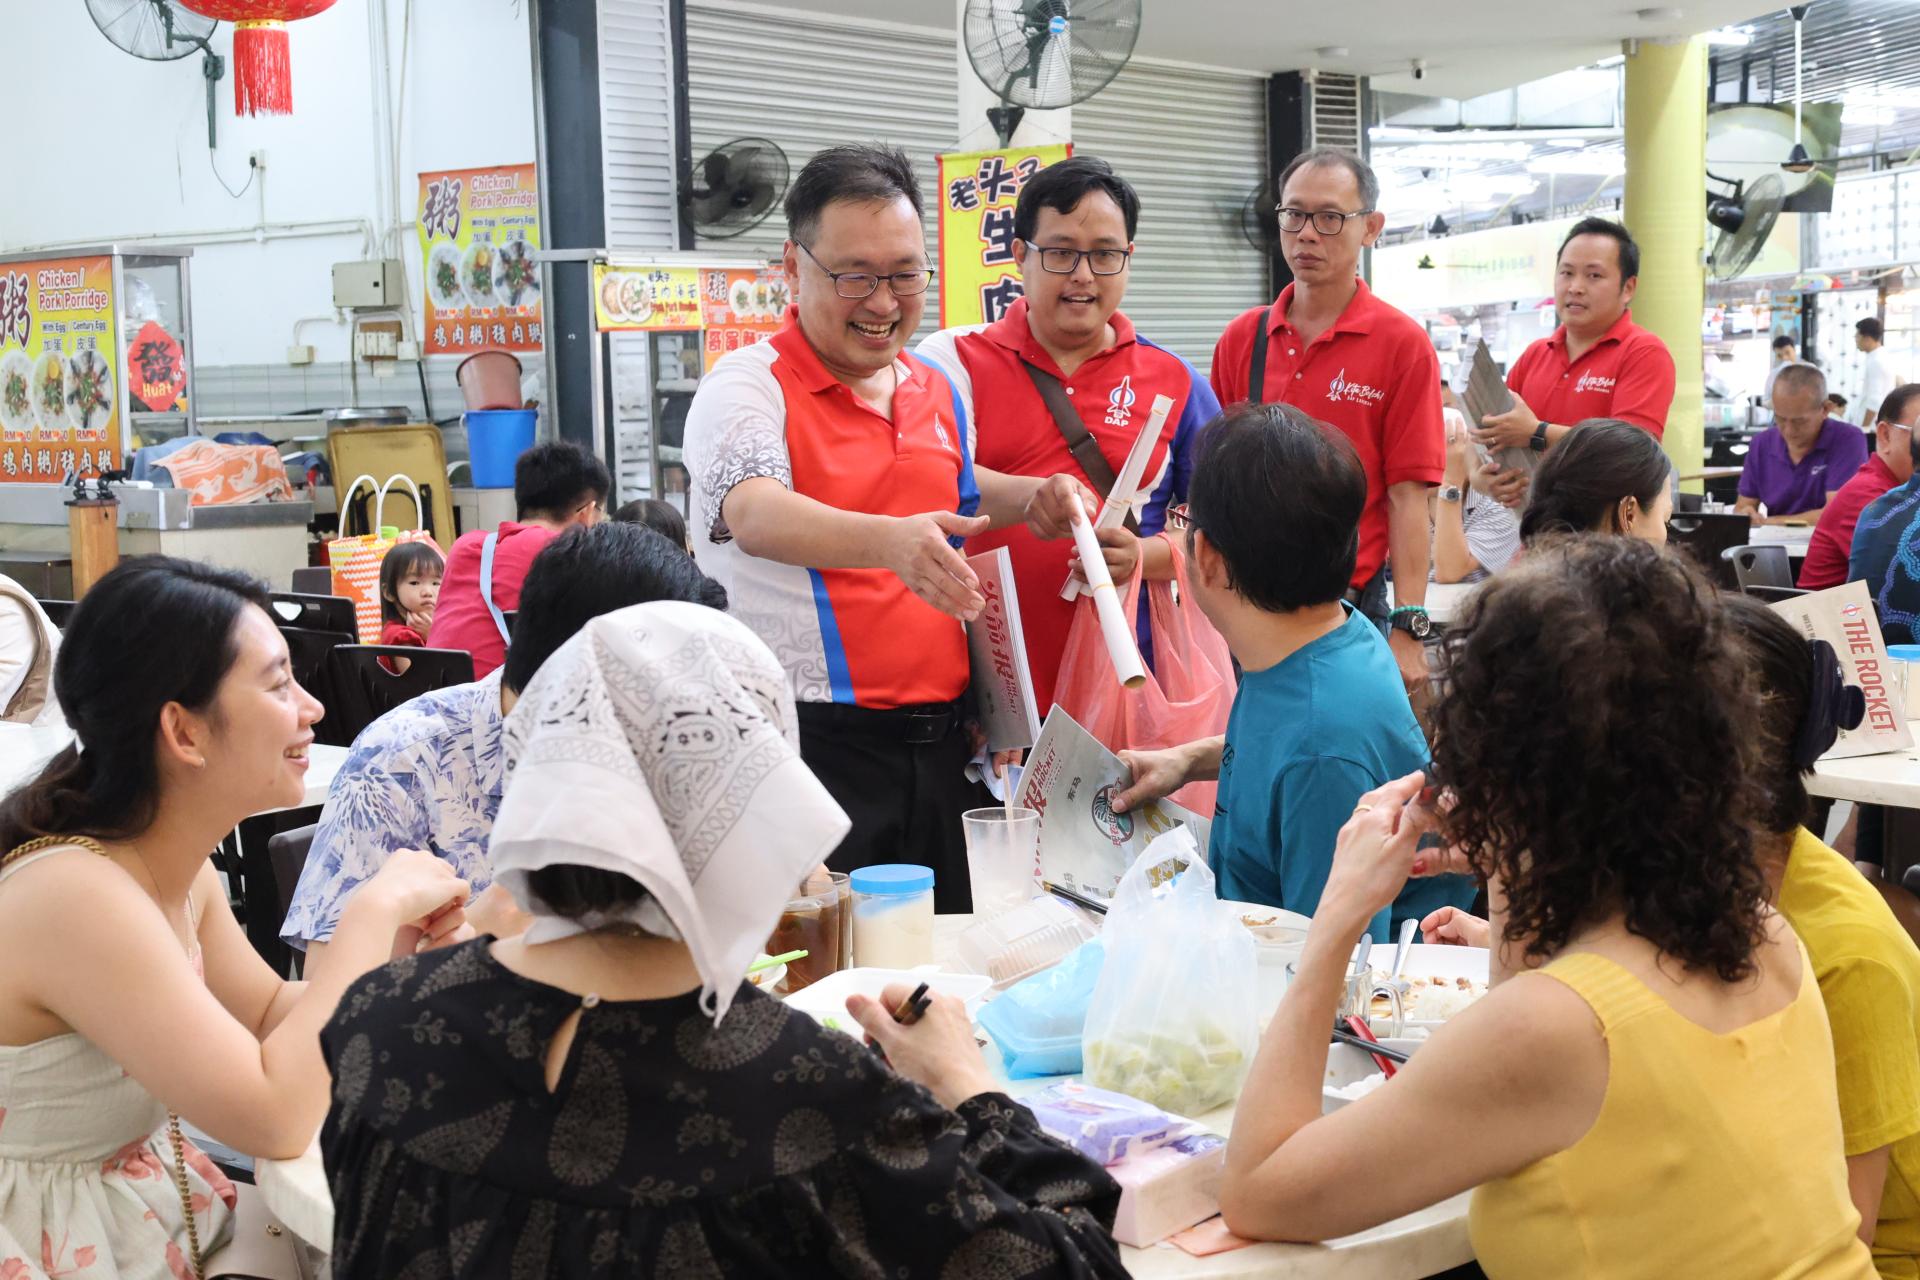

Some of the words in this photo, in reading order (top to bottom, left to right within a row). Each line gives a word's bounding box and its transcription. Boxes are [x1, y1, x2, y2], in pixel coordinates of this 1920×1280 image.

[423, 178, 462, 241] 粥
[470, 194, 493, 208] Pork
[39, 293, 62, 309] Pork
[64, 290, 107, 310] Porridge
[142, 382, 173, 398] Huat
[1104, 415, 1130, 427] DAP
[1842, 618, 1875, 655] THE
[1854, 658, 1898, 733] ROCKET
[1032, 759, 1045, 780] THE
[1036, 748, 1057, 789] ROCKET
